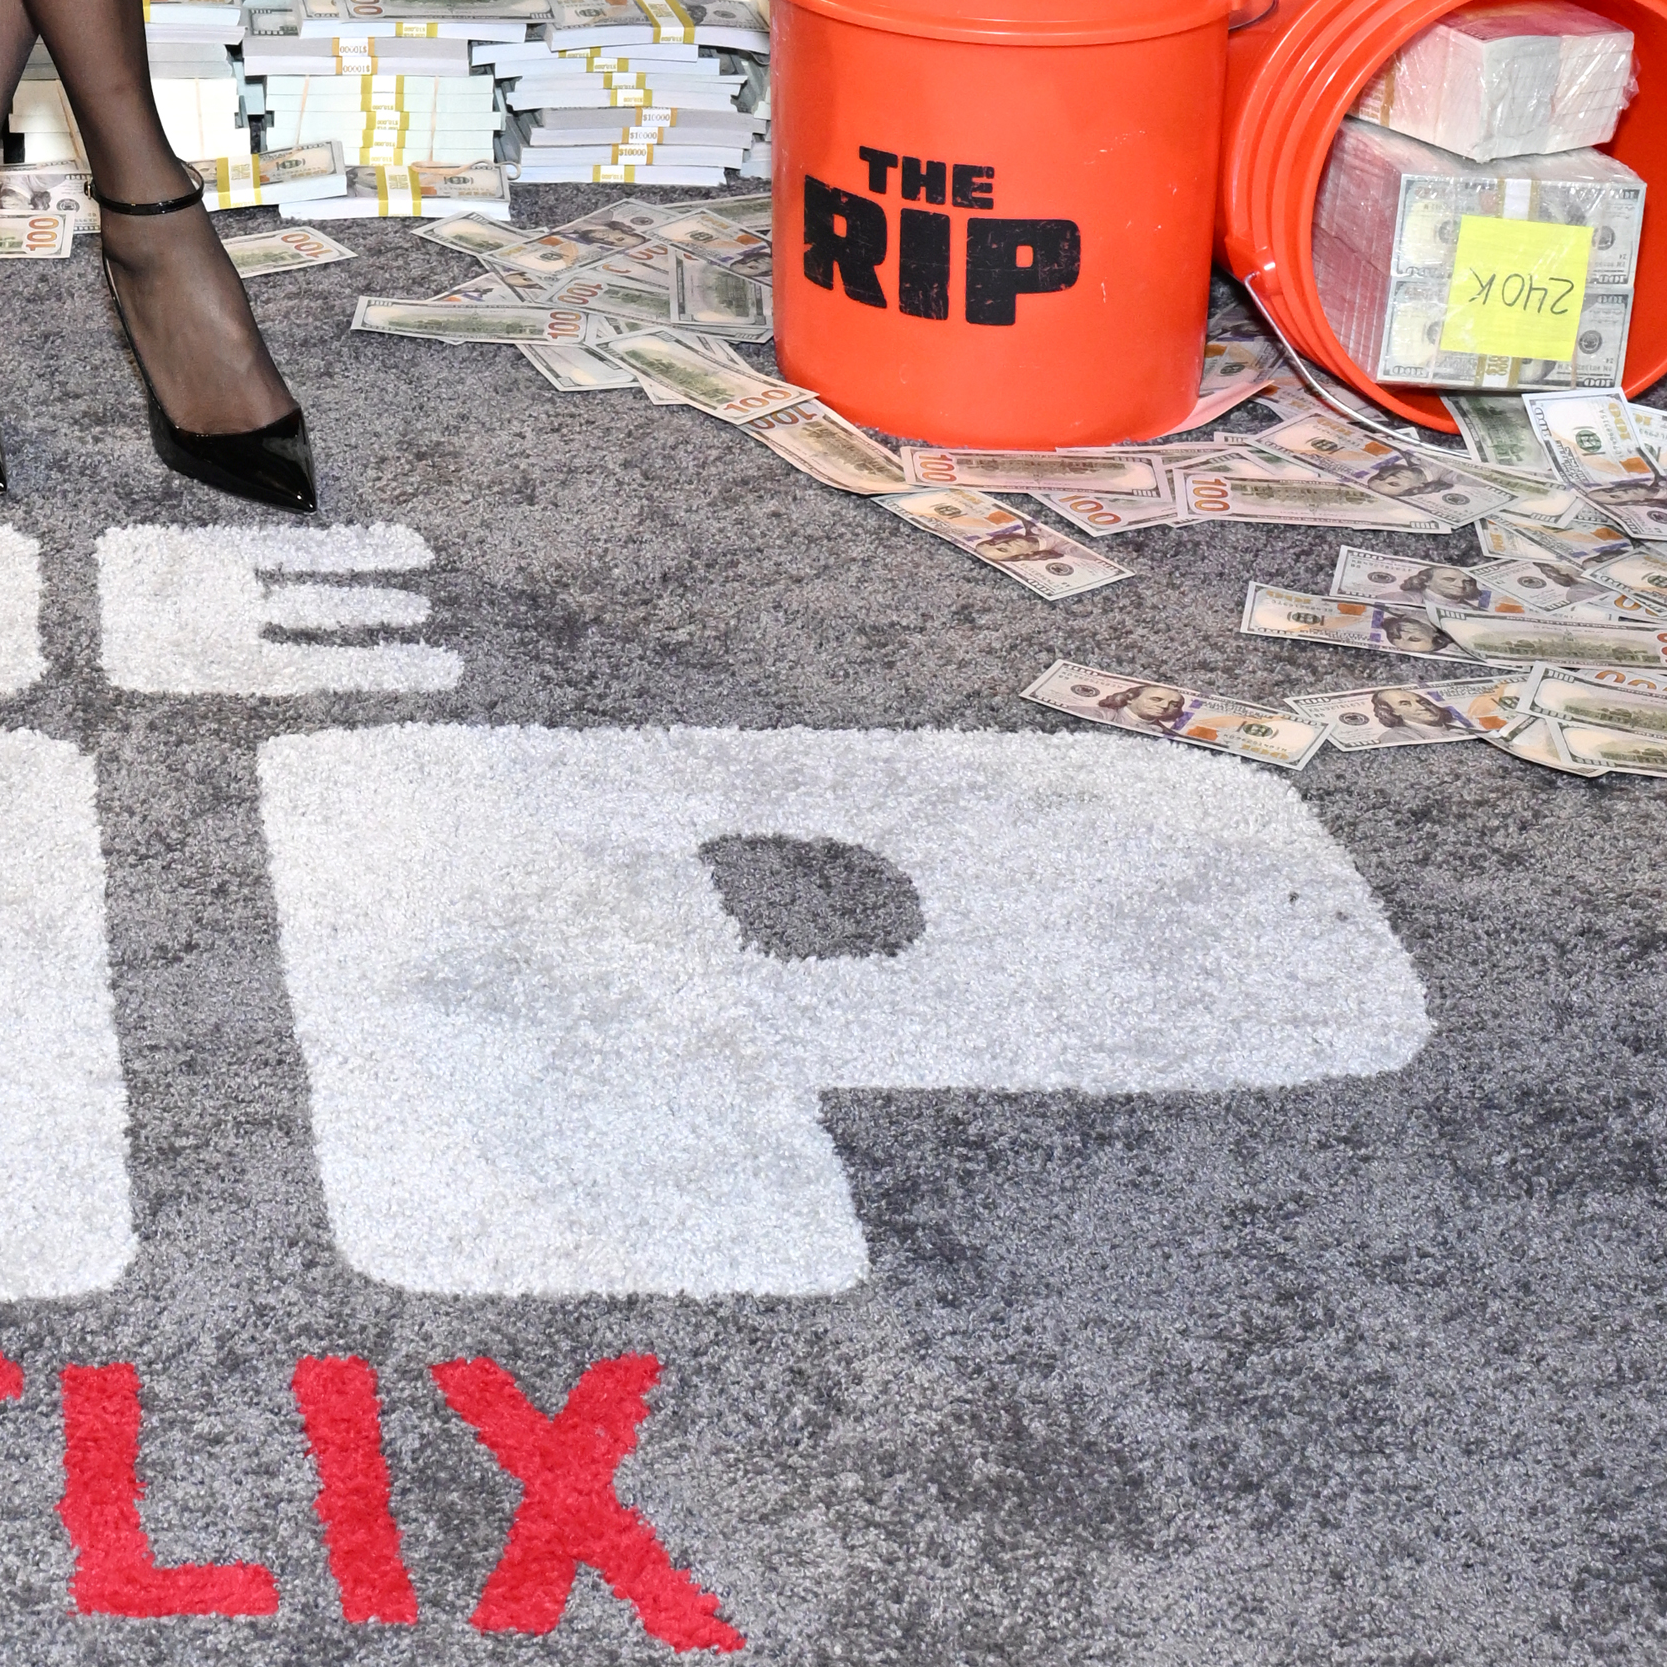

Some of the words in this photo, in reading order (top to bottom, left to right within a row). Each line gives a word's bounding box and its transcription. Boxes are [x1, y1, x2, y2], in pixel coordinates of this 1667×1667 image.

[859, 145, 995, 210] THE
[27, 218, 59, 251] 100
[281, 235, 333, 258] 100
[804, 174, 1081, 326] RIP
[558, 282, 603, 305] 100
[1468, 267, 1575, 315] 240K
[547, 311, 582, 340] 100
[723, 387, 792, 414] 100
[918, 454, 957, 483] 100
[1058, 494, 1122, 526] 100
[1191, 478, 1231, 512] 100
